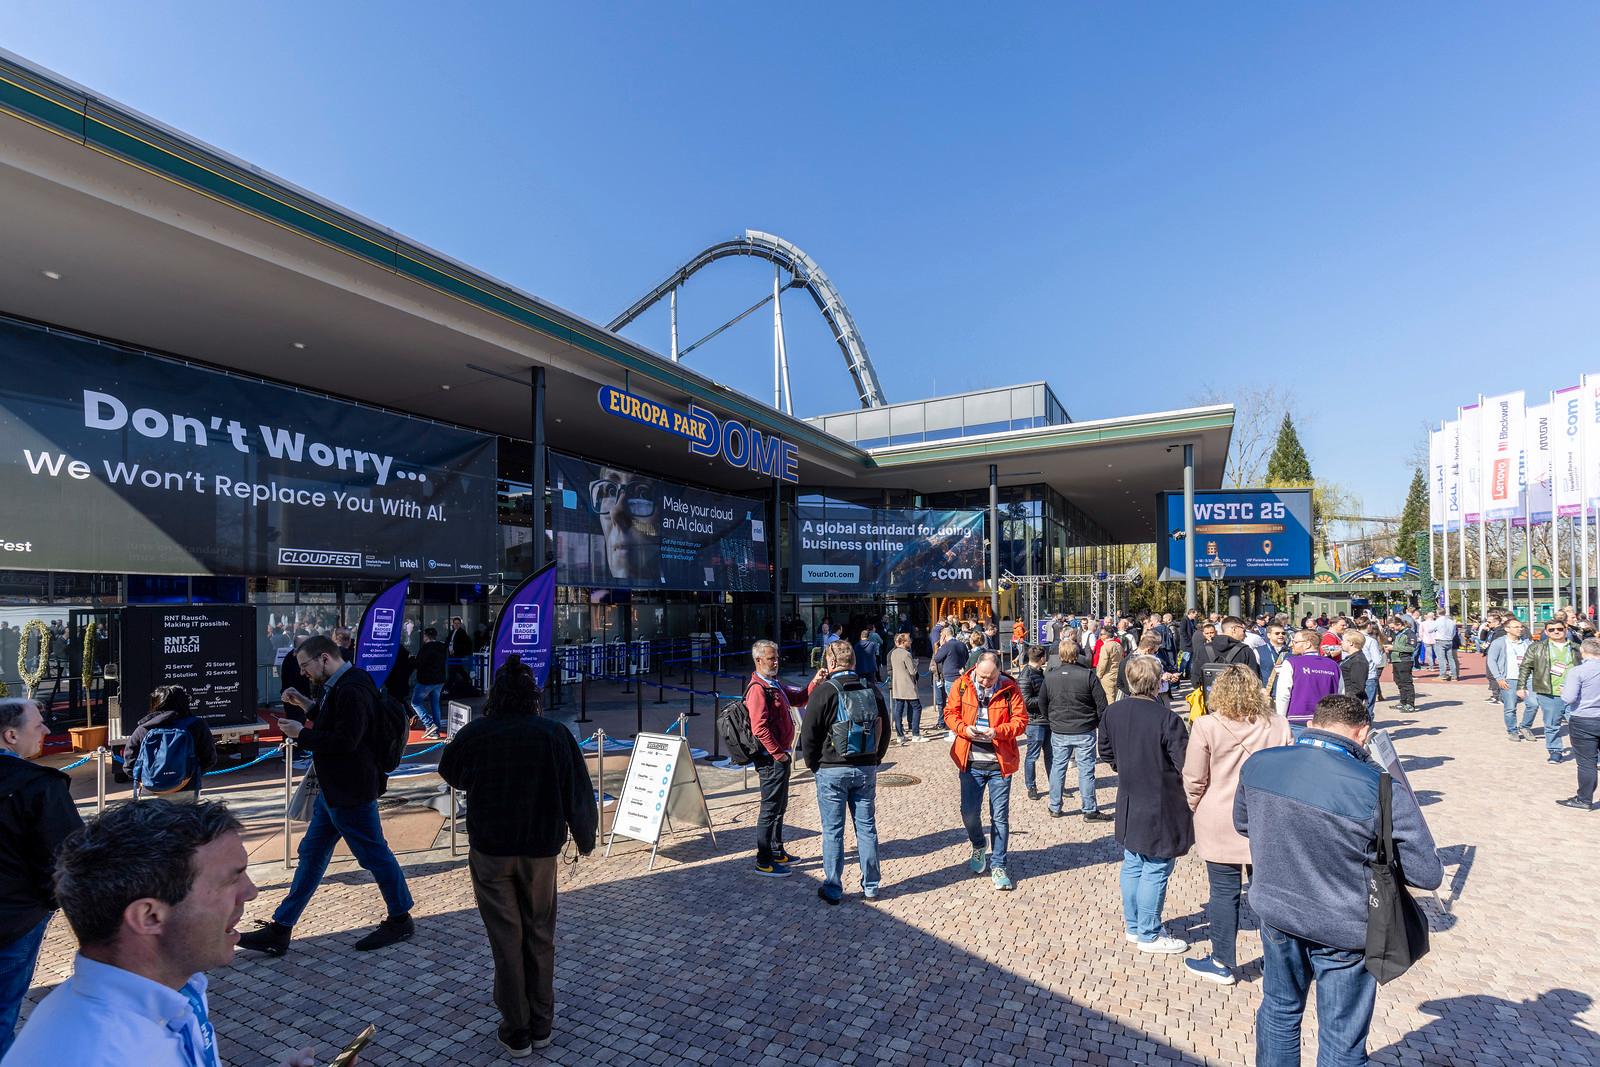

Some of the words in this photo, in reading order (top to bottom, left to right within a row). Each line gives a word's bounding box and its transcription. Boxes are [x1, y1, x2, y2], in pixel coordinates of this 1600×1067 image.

[609, 389, 670, 428] EUROPA
[673, 412, 707, 441] PARK
[1499, 400, 1508, 440] Blackwall
[689, 403, 799, 484] DOME
[259, 425, 427, 486] Worry...
[23, 449, 91, 480] We
[215, 475, 326, 507] Replace
[332, 490, 374, 513] You
[380, 497, 421, 519] With
[426, 503, 448, 522] AI.
[1494, 461, 1506, 497] Lenovo
[663, 495, 689, 514] Make
[690, 503, 710, 517] your
[710, 506, 733, 521] cloud
[1193, 502, 1254, 520] WSTC
[1260, 502, 1286, 519] 25
[662, 517, 675, 529] an
[676, 516, 688, 531] AI
[688, 520, 714, 534] cloud
[802, 520, 814, 533] A
[816, 522, 856, 536] global
[859, 523, 915, 536] standard
[917, 524, 934, 536] for
[937, 526, 972, 538] doing
[802, 537, 863, 551] business
[865, 539, 904, 551] online
[281, 551, 359, 567] CLOUDFEST
[399, 558, 419, 569] intel
[808, 570, 855, 578] YourDot.com
[931, 567, 973, 580] .com
[164, 636, 187, 645] RNT
[164, 644, 200, 654] RAUSCH
